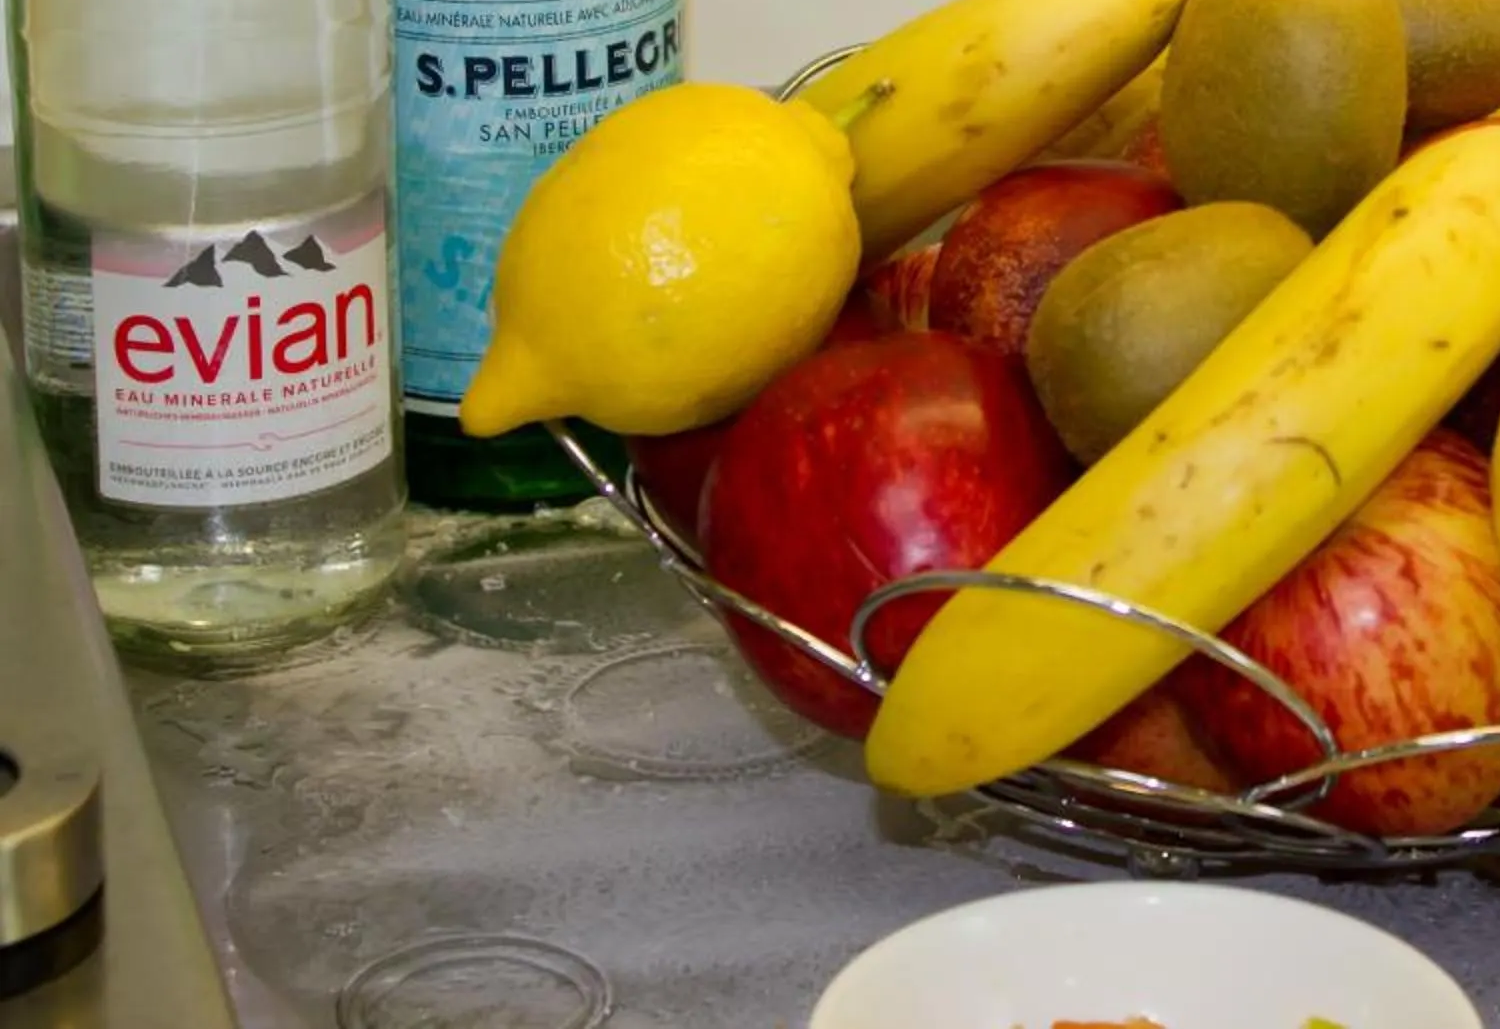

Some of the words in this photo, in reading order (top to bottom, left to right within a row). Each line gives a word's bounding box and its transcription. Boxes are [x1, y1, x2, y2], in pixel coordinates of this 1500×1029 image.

[397, 7, 422, 24] EAU
[426, 11, 495, 28] MINÉRALE
[500, 10, 574, 28] NATURELLE
[577, 3, 609, 22] AVEC
[416, 12, 680, 97] S.PELLEGRI
[480, 123, 532, 143] SAN
[114, 283, 376, 384] evian
[115, 388, 154, 405] EAU
[164, 389, 273, 407] MINERALE
[283, 354, 375, 399] NATURELLE
